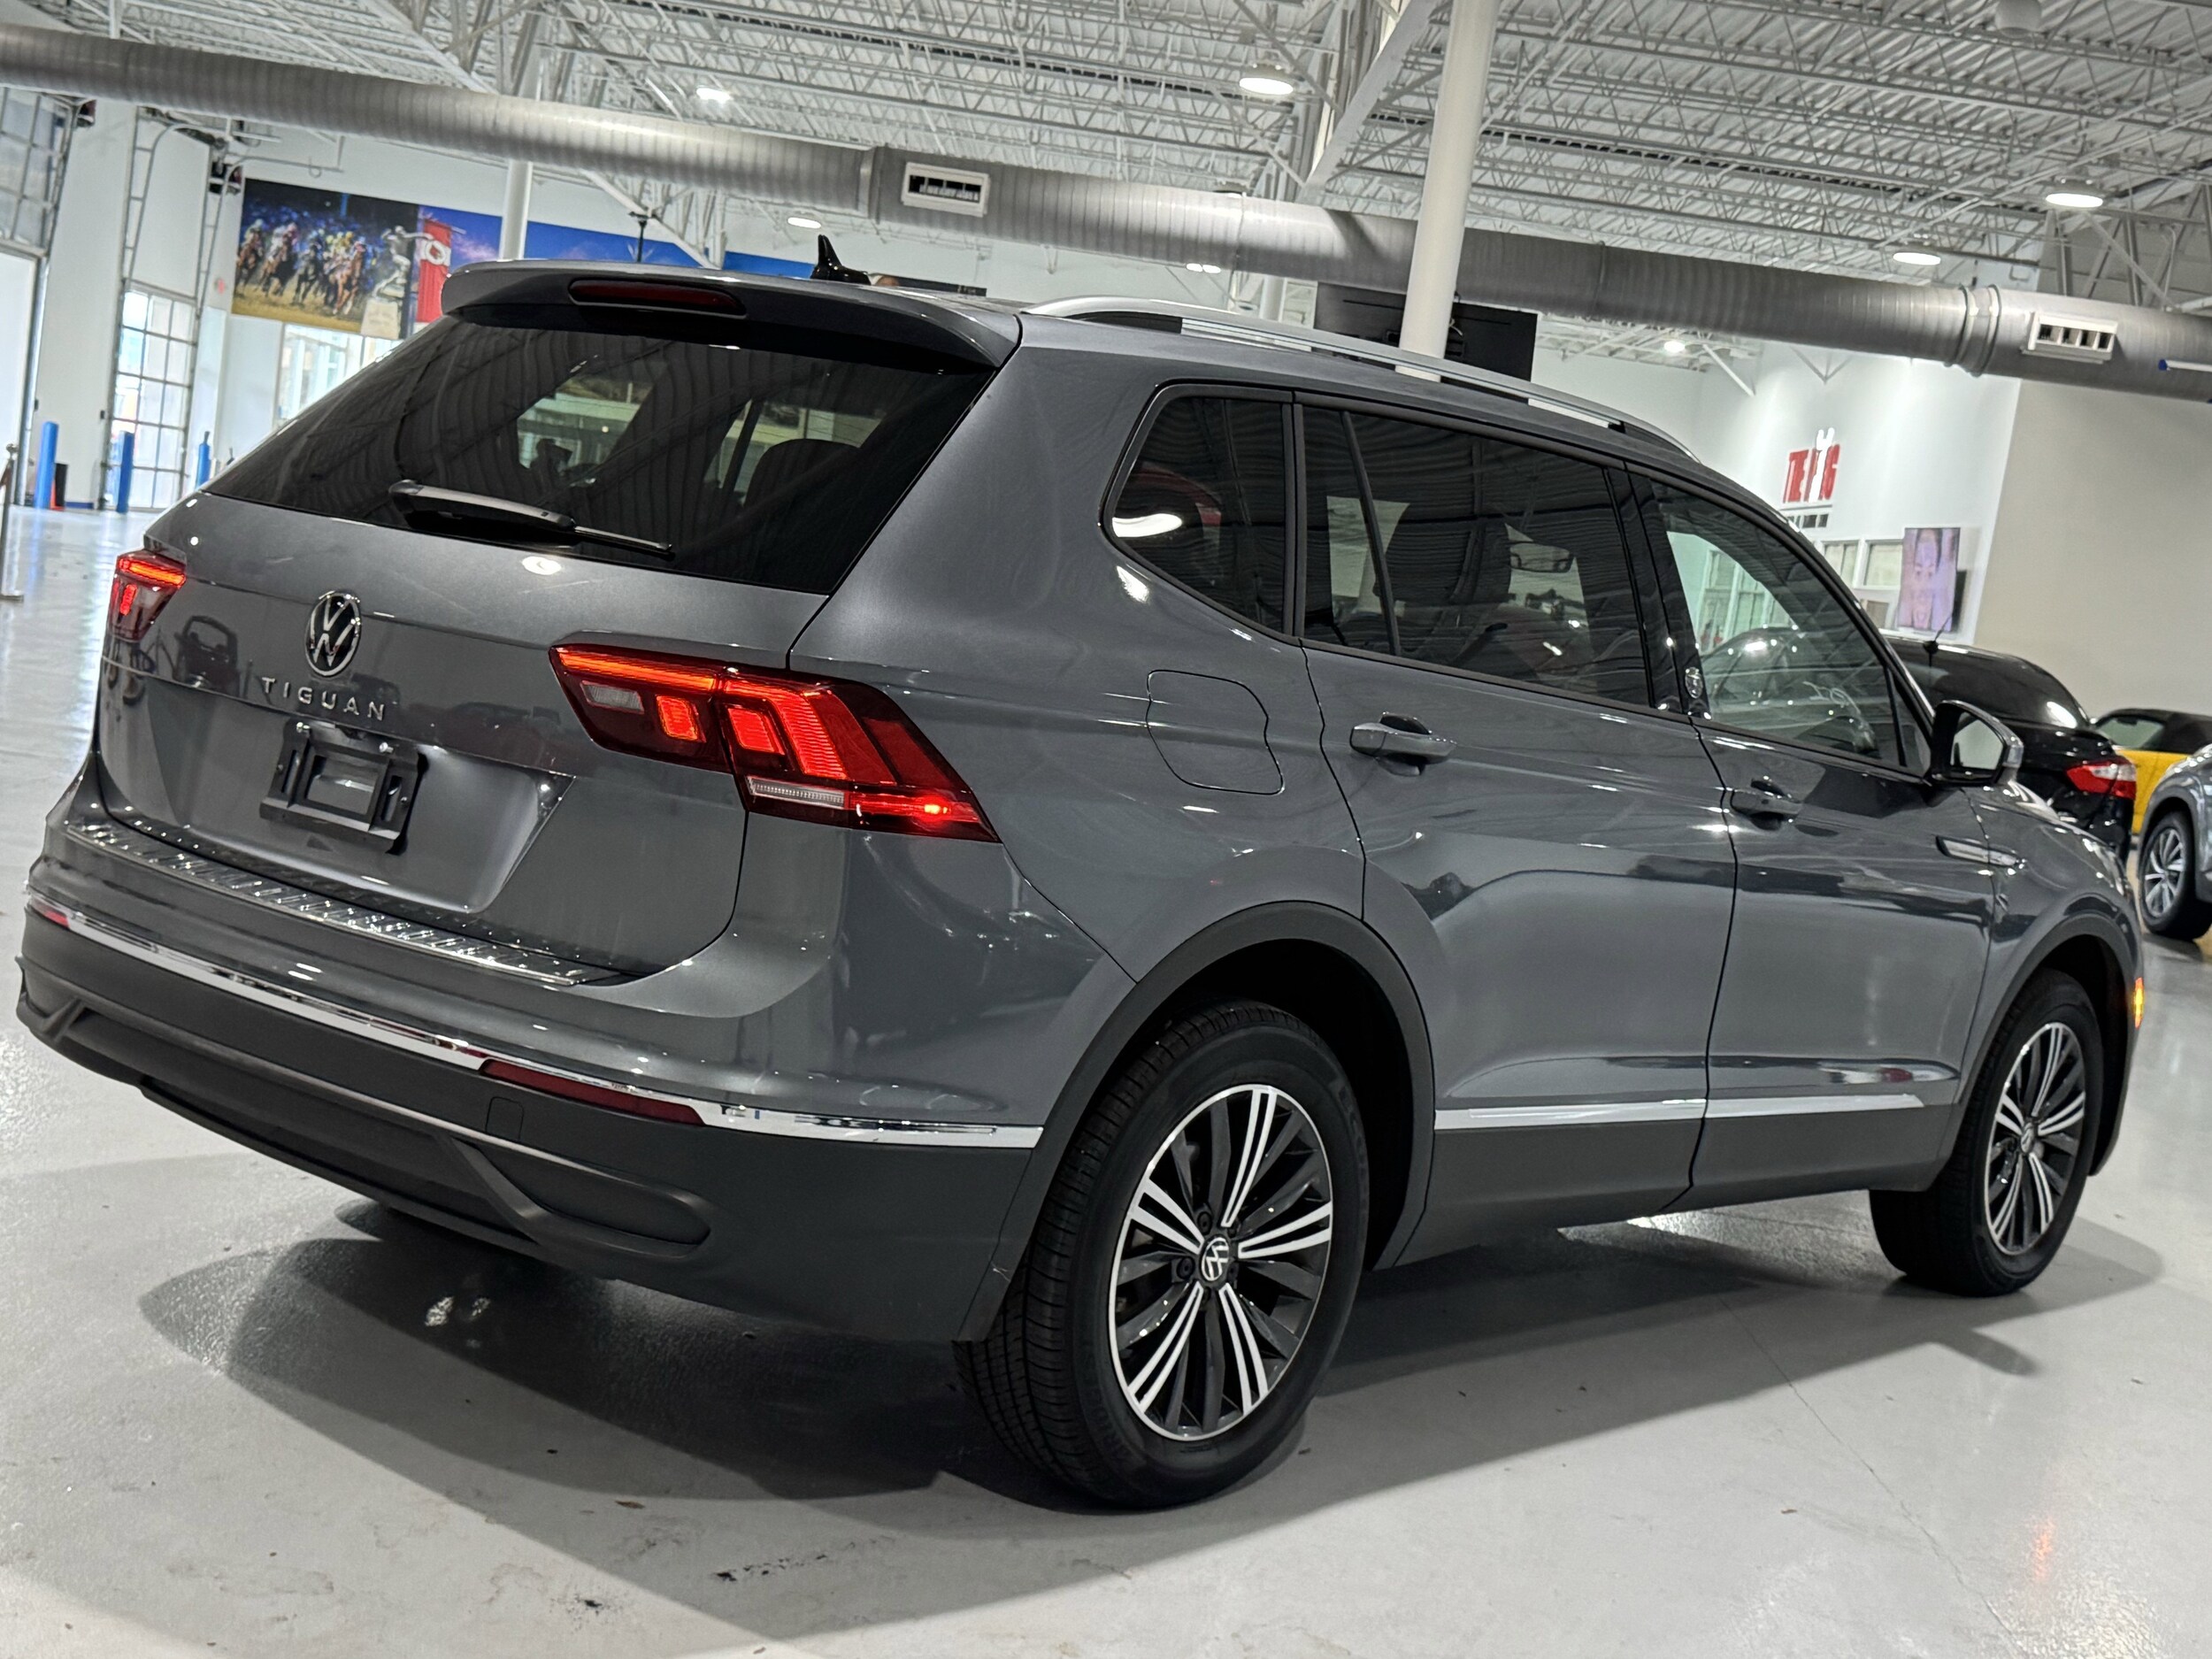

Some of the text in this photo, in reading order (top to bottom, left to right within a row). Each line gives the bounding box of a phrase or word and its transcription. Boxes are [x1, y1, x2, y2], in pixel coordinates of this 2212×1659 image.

[307, 592, 360, 675] VW
[261, 676, 385, 721] TIGUAN
[1202, 1237, 1229, 1281] VW
